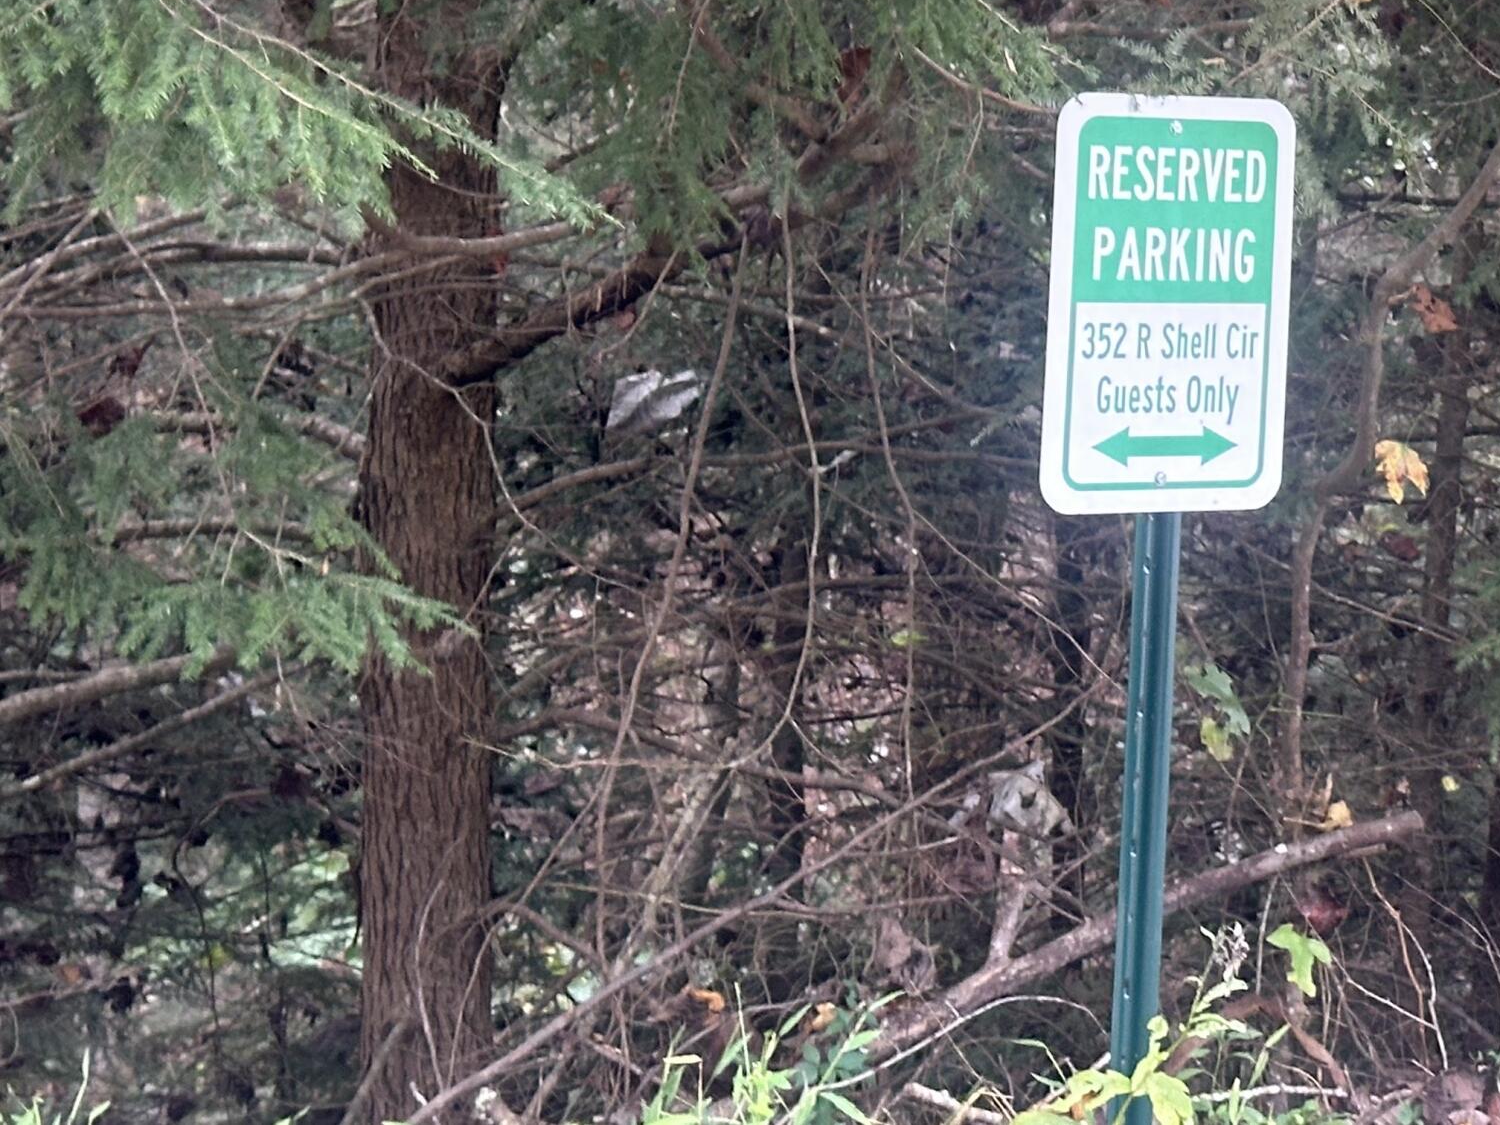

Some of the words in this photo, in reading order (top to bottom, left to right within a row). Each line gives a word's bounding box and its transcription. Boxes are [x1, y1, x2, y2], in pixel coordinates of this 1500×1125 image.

[1087, 144, 1267, 204] RESERVED
[1092, 226, 1256, 283] PARKING
[1081, 322, 1128, 359] 352
[1136, 322, 1152, 359] R
[1160, 322, 1218, 359] Shell
[1225, 322, 1259, 359] Cir
[1096, 375, 1177, 414] Guests
[1186, 375, 1240, 425] Only
